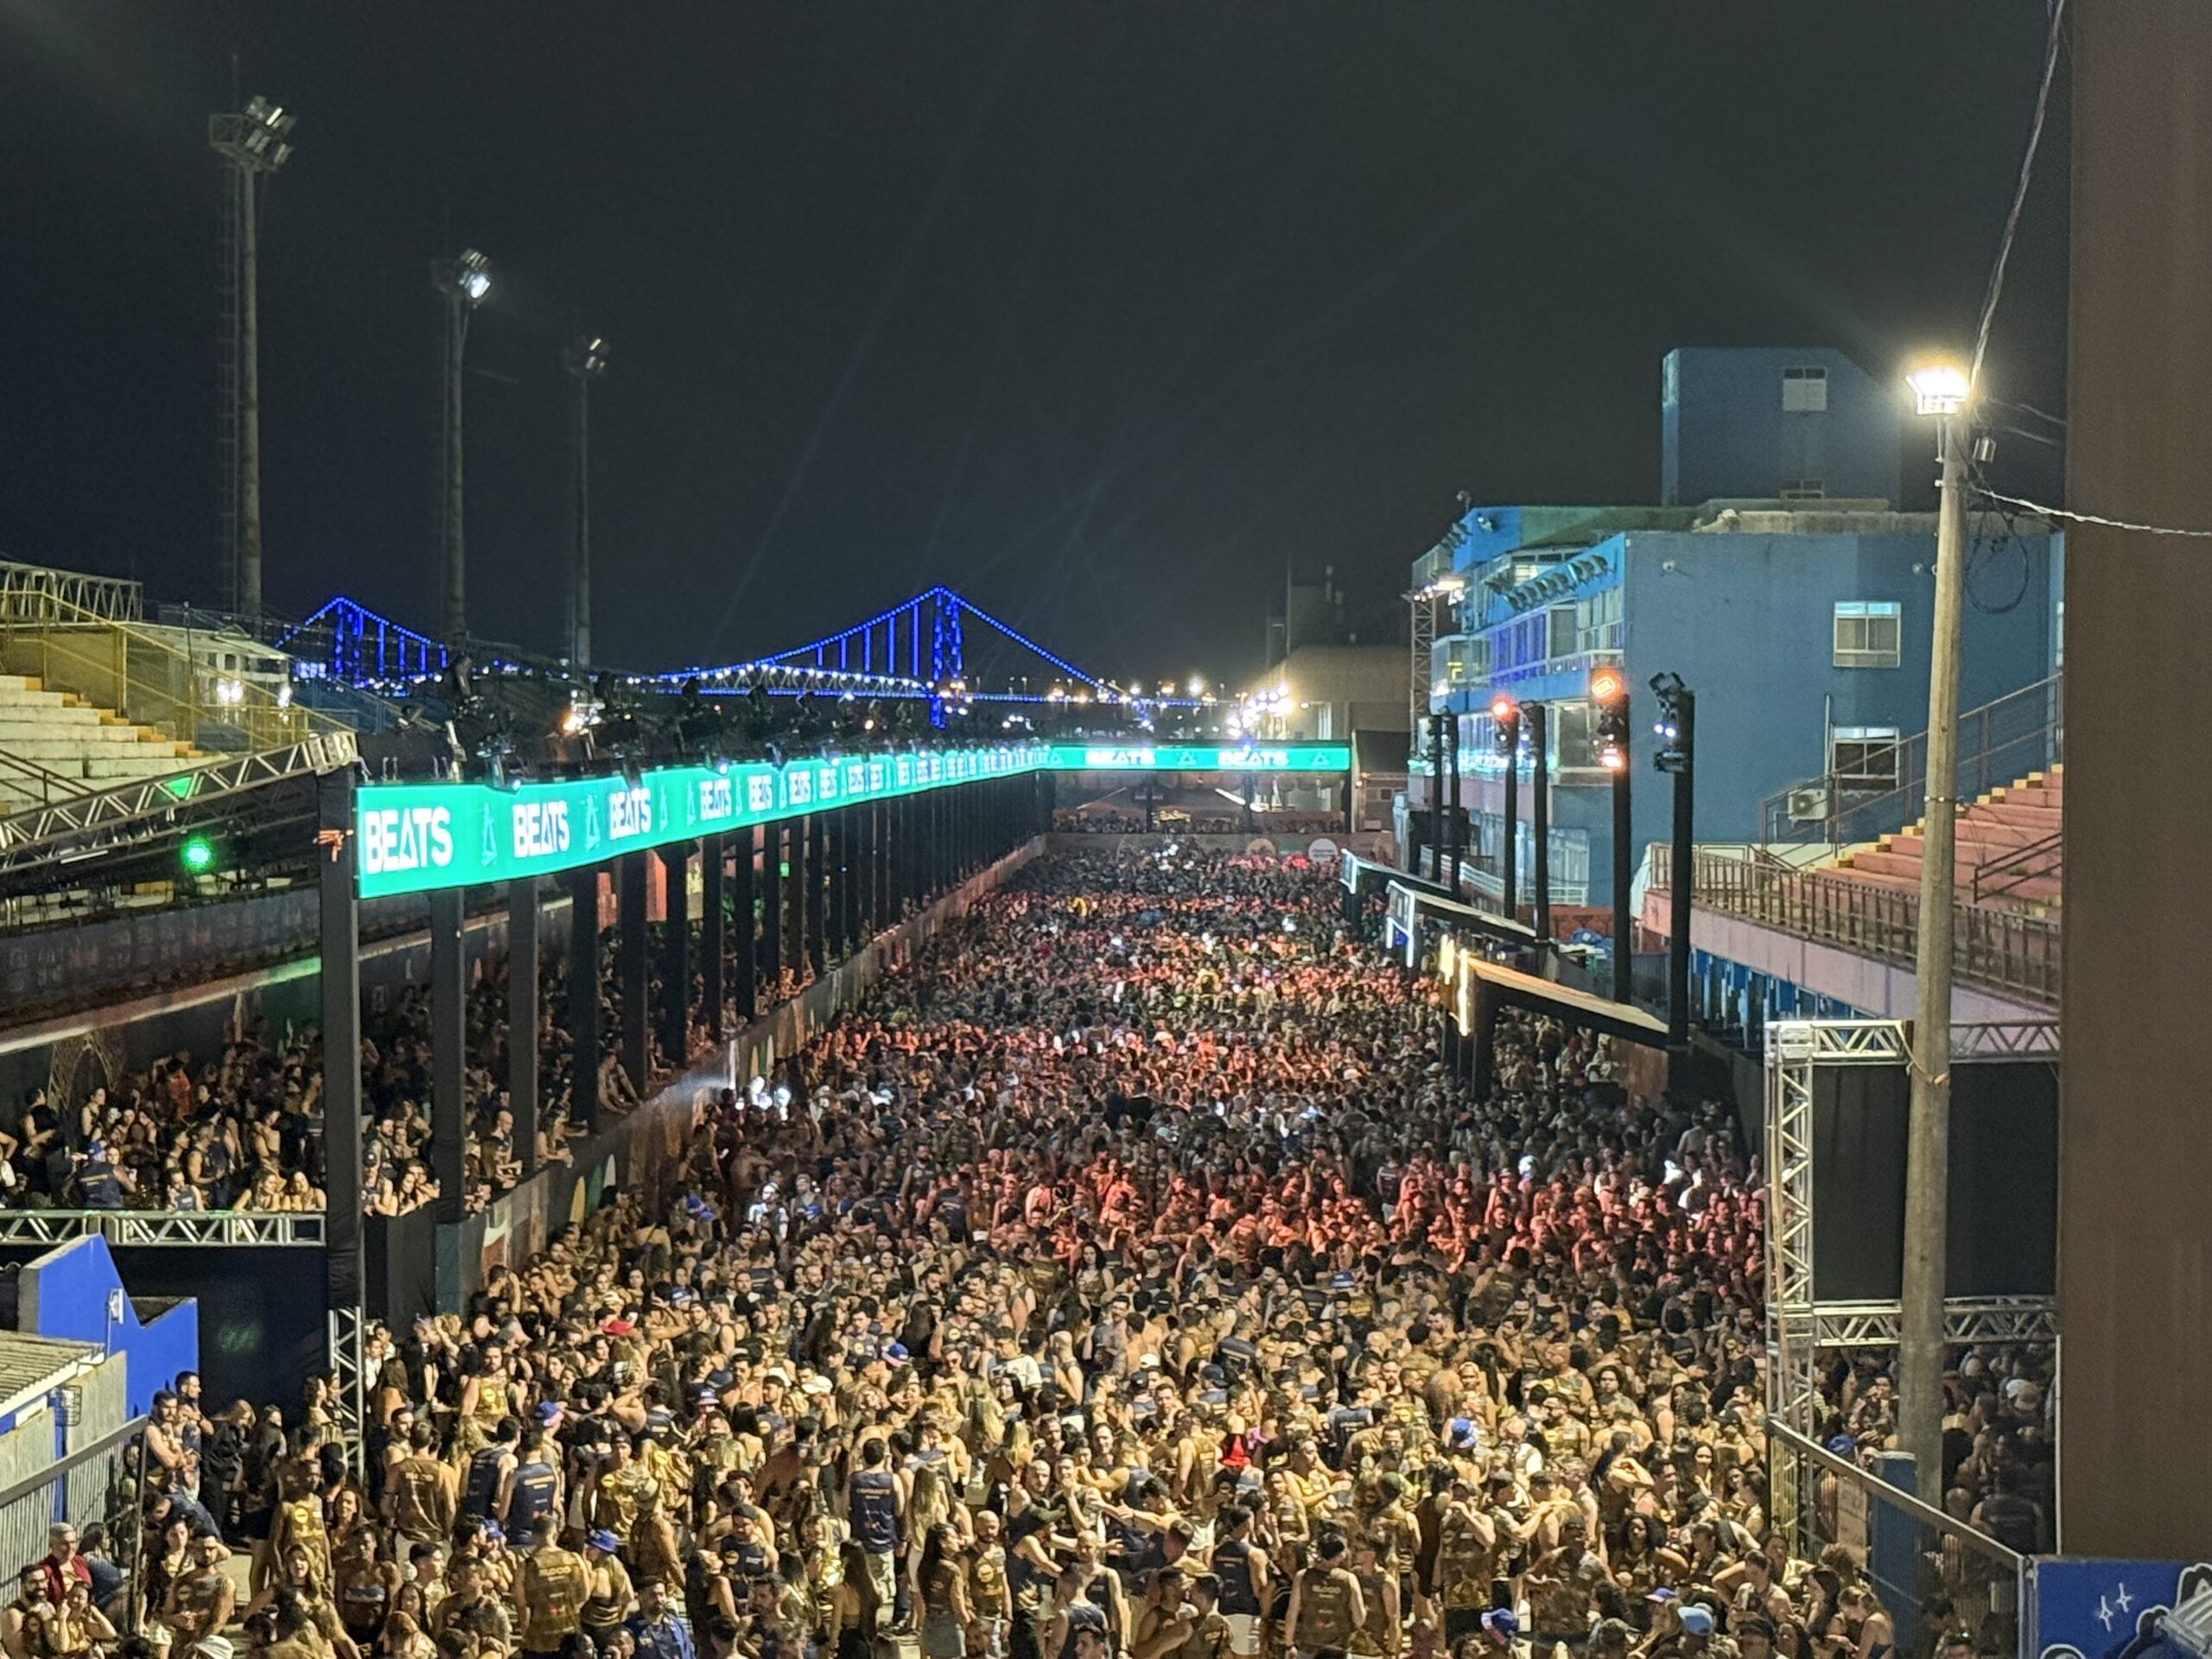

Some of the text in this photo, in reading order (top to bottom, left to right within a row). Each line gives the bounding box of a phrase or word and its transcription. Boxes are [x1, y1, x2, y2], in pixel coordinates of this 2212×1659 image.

[363, 805, 453, 874] BEATS
[512, 800, 570, 858] BEATS
[609, 787, 652, 840] BEATS
[700, 779, 731, 820] BEATS
